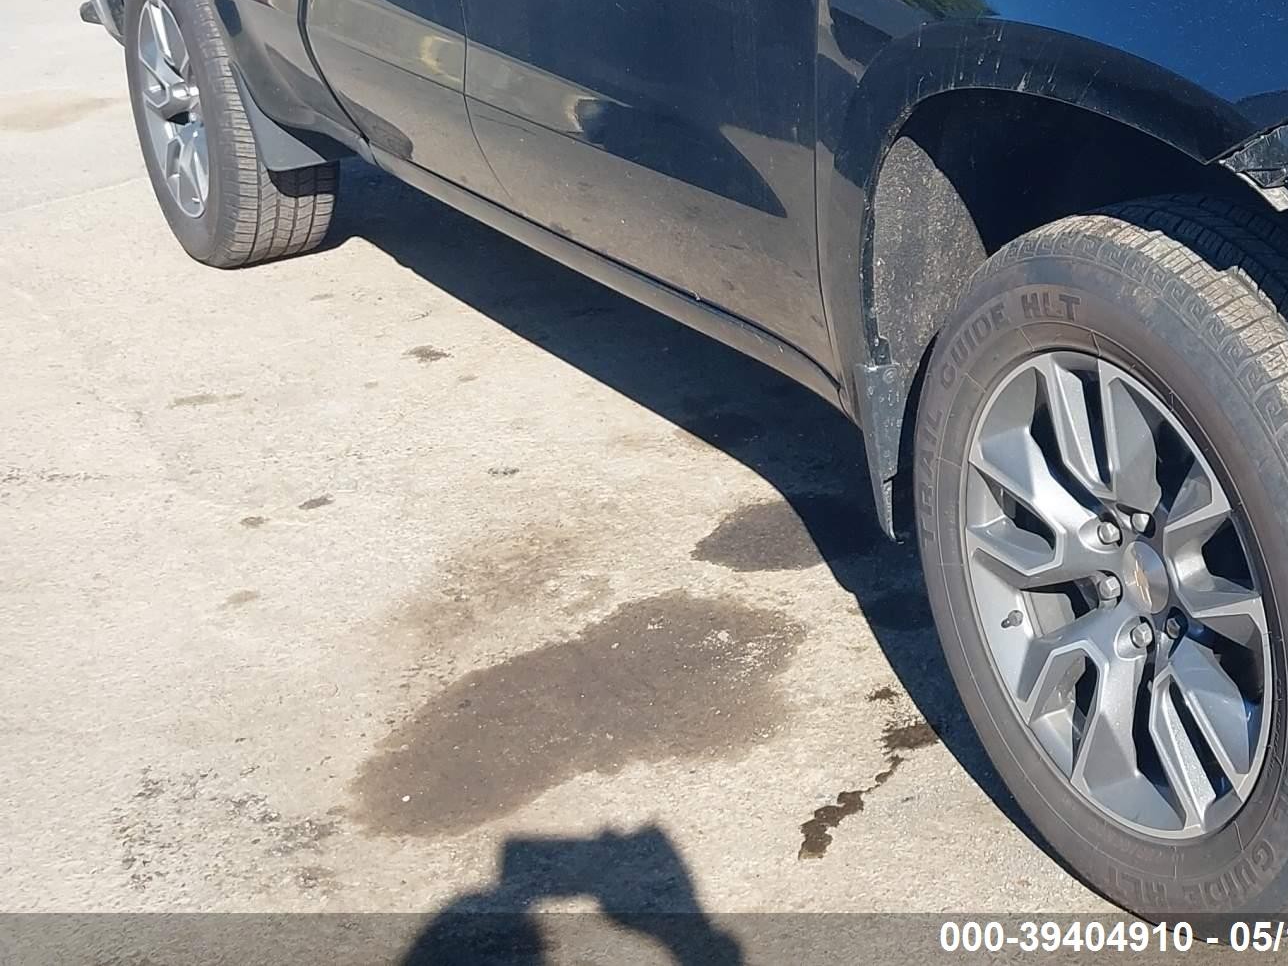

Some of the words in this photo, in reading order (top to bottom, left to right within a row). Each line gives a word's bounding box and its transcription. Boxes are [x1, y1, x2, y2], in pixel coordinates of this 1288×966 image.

[920, 408, 943, 549] TRAIL
[941, 304, 1012, 390] GUIDE
[1021, 293, 1081, 322] HLT
